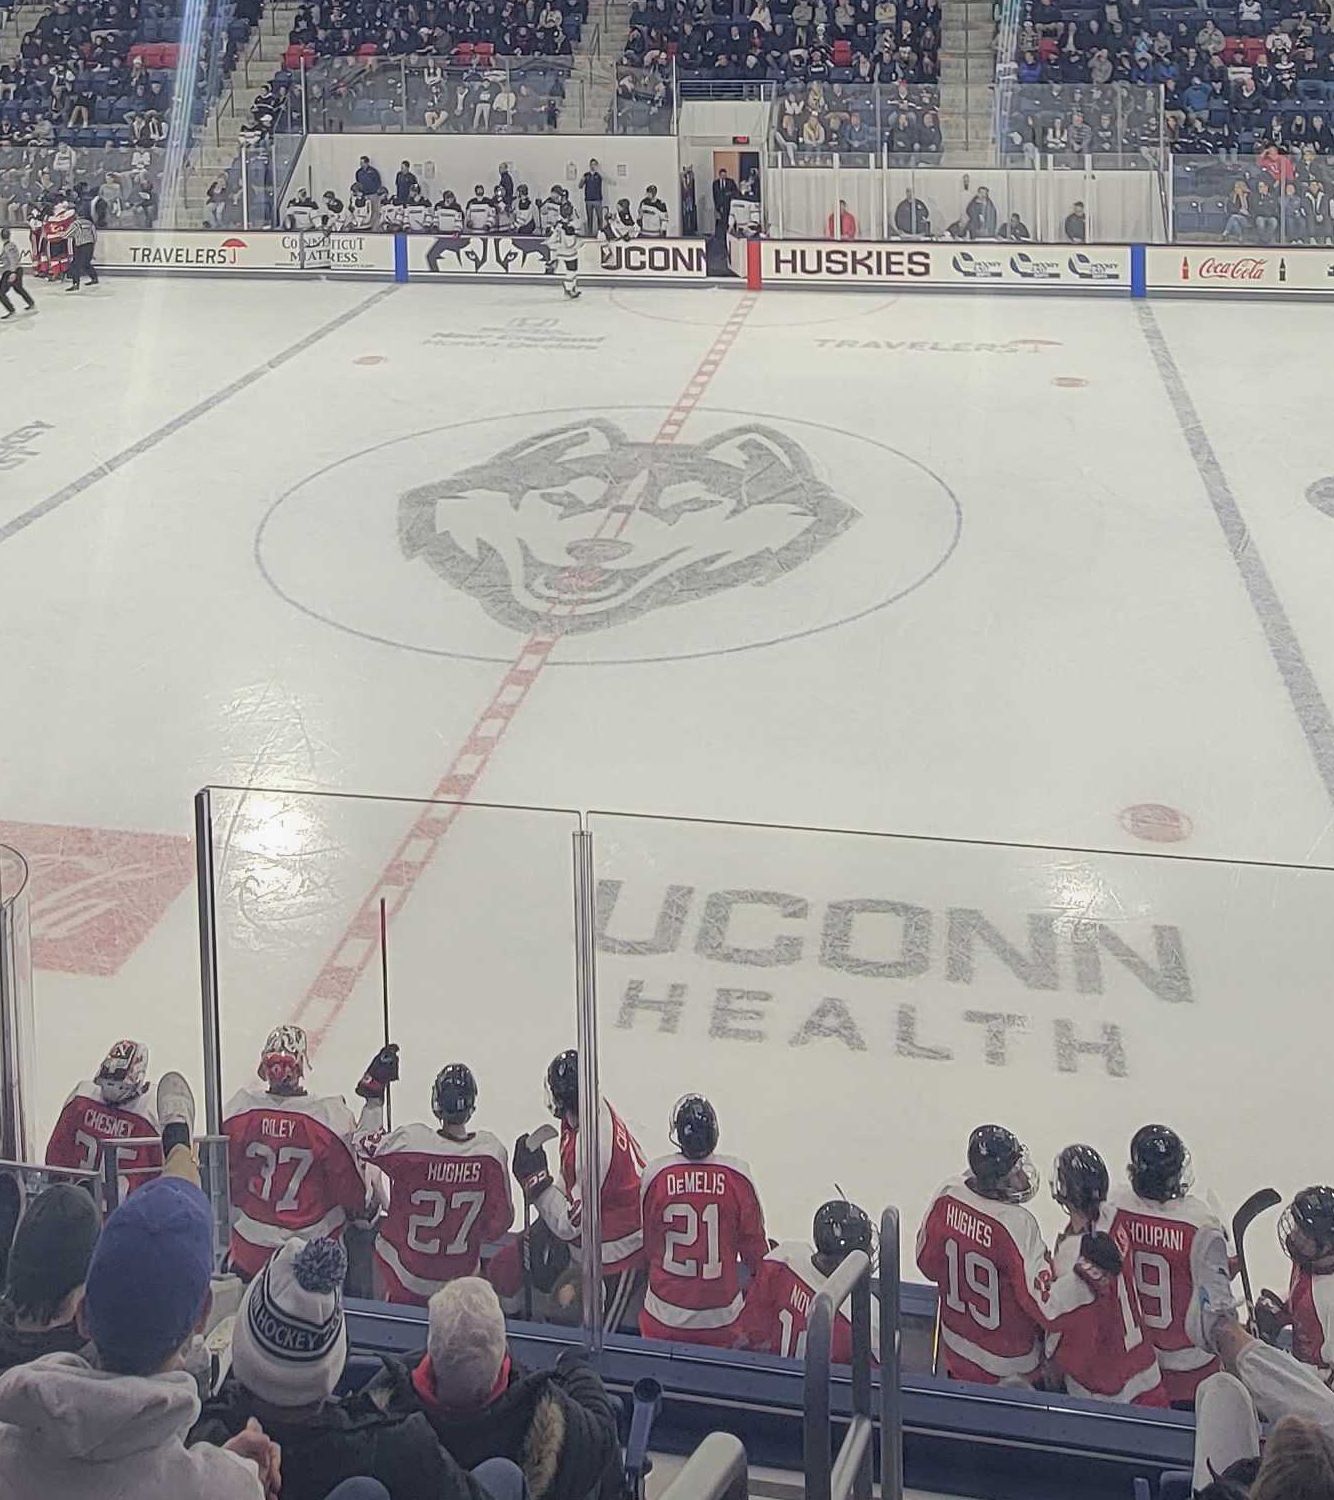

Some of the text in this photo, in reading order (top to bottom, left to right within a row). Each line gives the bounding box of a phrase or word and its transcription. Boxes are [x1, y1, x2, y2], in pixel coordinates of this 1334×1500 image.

[130, 247, 227, 264] TRAVELERS
[774, 249, 931, 276] HUSKIES
[1199, 256, 1269, 281] Coca-Cola
[594, 879, 1195, 1004] UCONN
[614, 979, 1128, 1078] HEALTH
[261, 1118, 297, 1138] RILEY
[246, 1140, 315, 1213] 37
[427, 1162, 482, 1183] HUGHES
[406, 1189, 486, 1256] 27
[661, 1203, 724, 1280] 21
[945, 1203, 994, 1248] HUGHES
[943, 1237, 1000, 1331] 19
